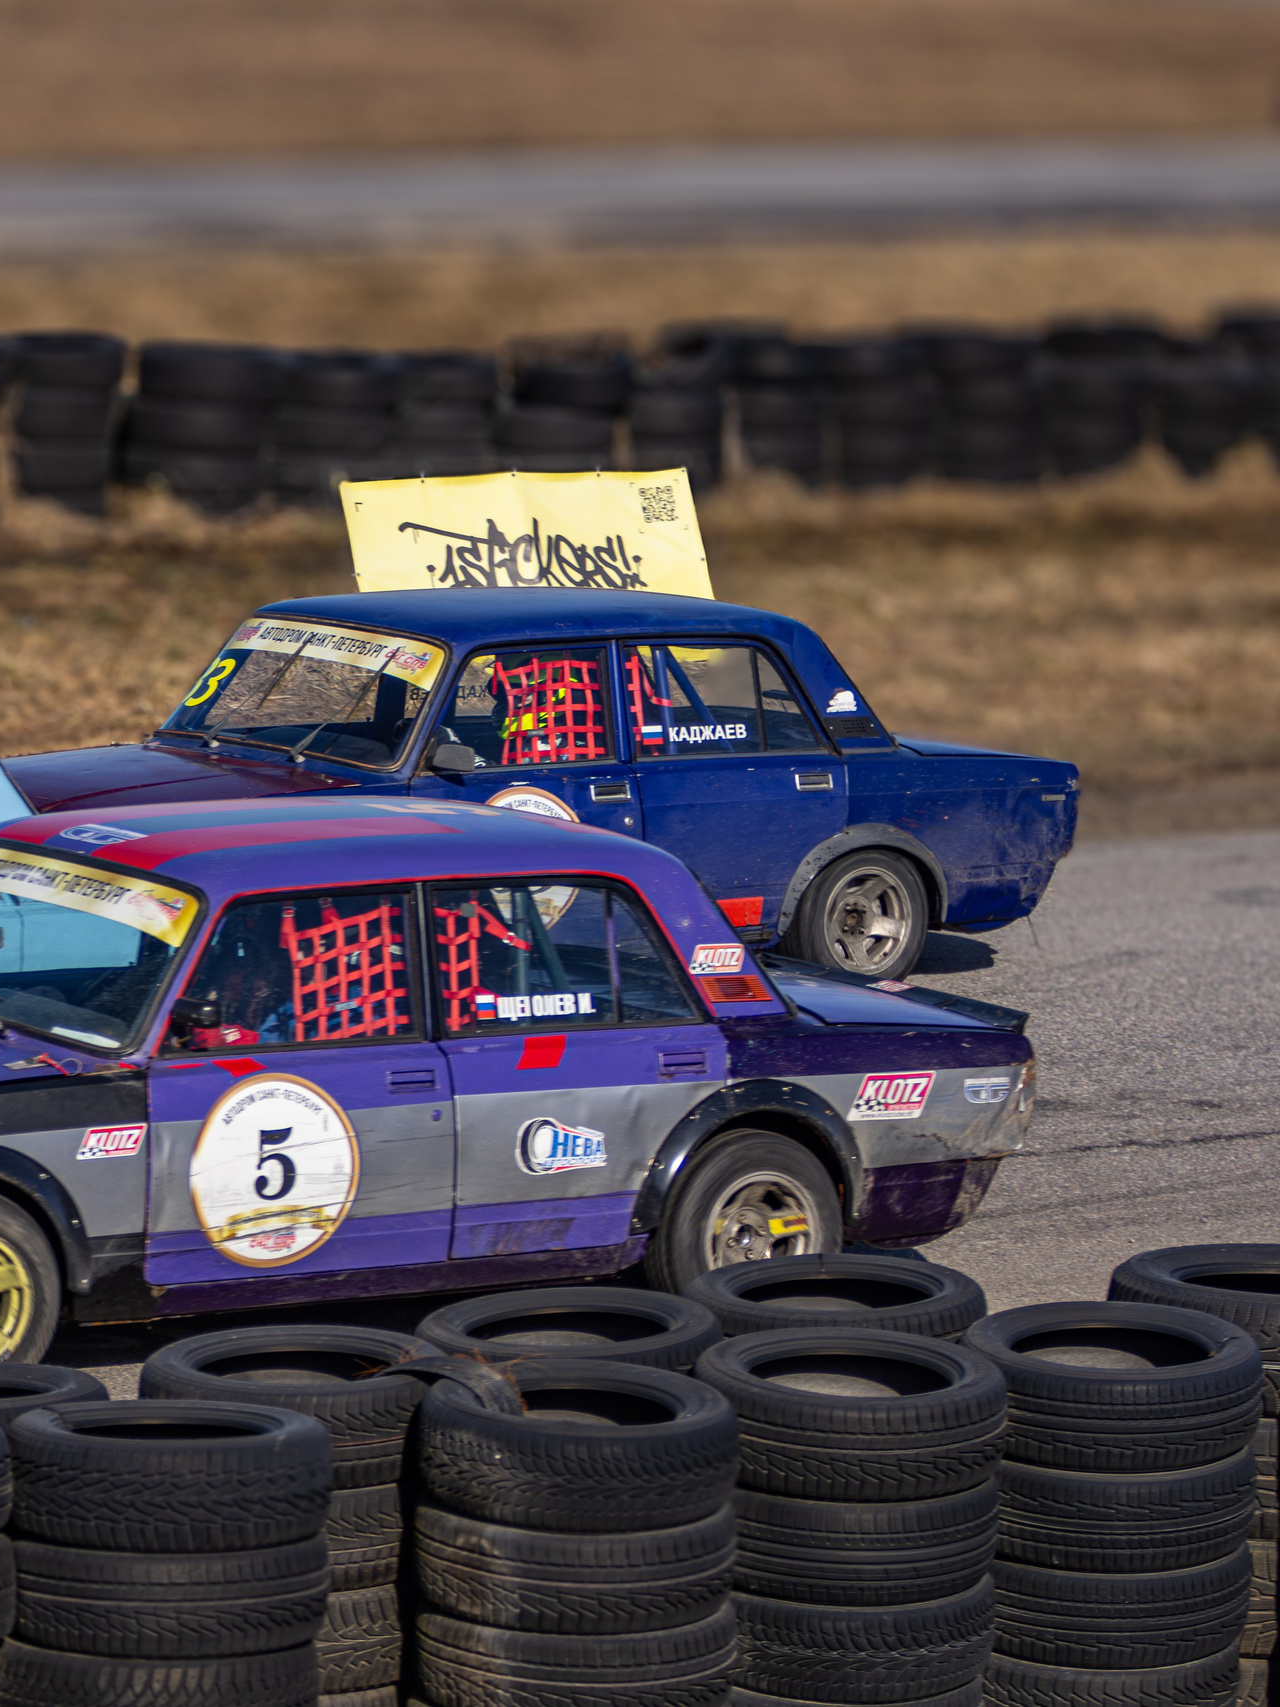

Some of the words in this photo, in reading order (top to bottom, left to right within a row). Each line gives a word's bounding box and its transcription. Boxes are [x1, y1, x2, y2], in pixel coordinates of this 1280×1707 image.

[257, 626, 308, 644] АВТОДРОМ
[303, 631, 388, 659] САНКТ-ПЕТЕРБУРГ
[668, 723, 748, 745] КАДЖАЕВ
[695, 948, 742, 967] KLOTZ
[862, 1077, 931, 1104] KLOTZ
[86, 1128, 143, 1151] KLOTZ
[254, 1126, 296, 1201] 5
